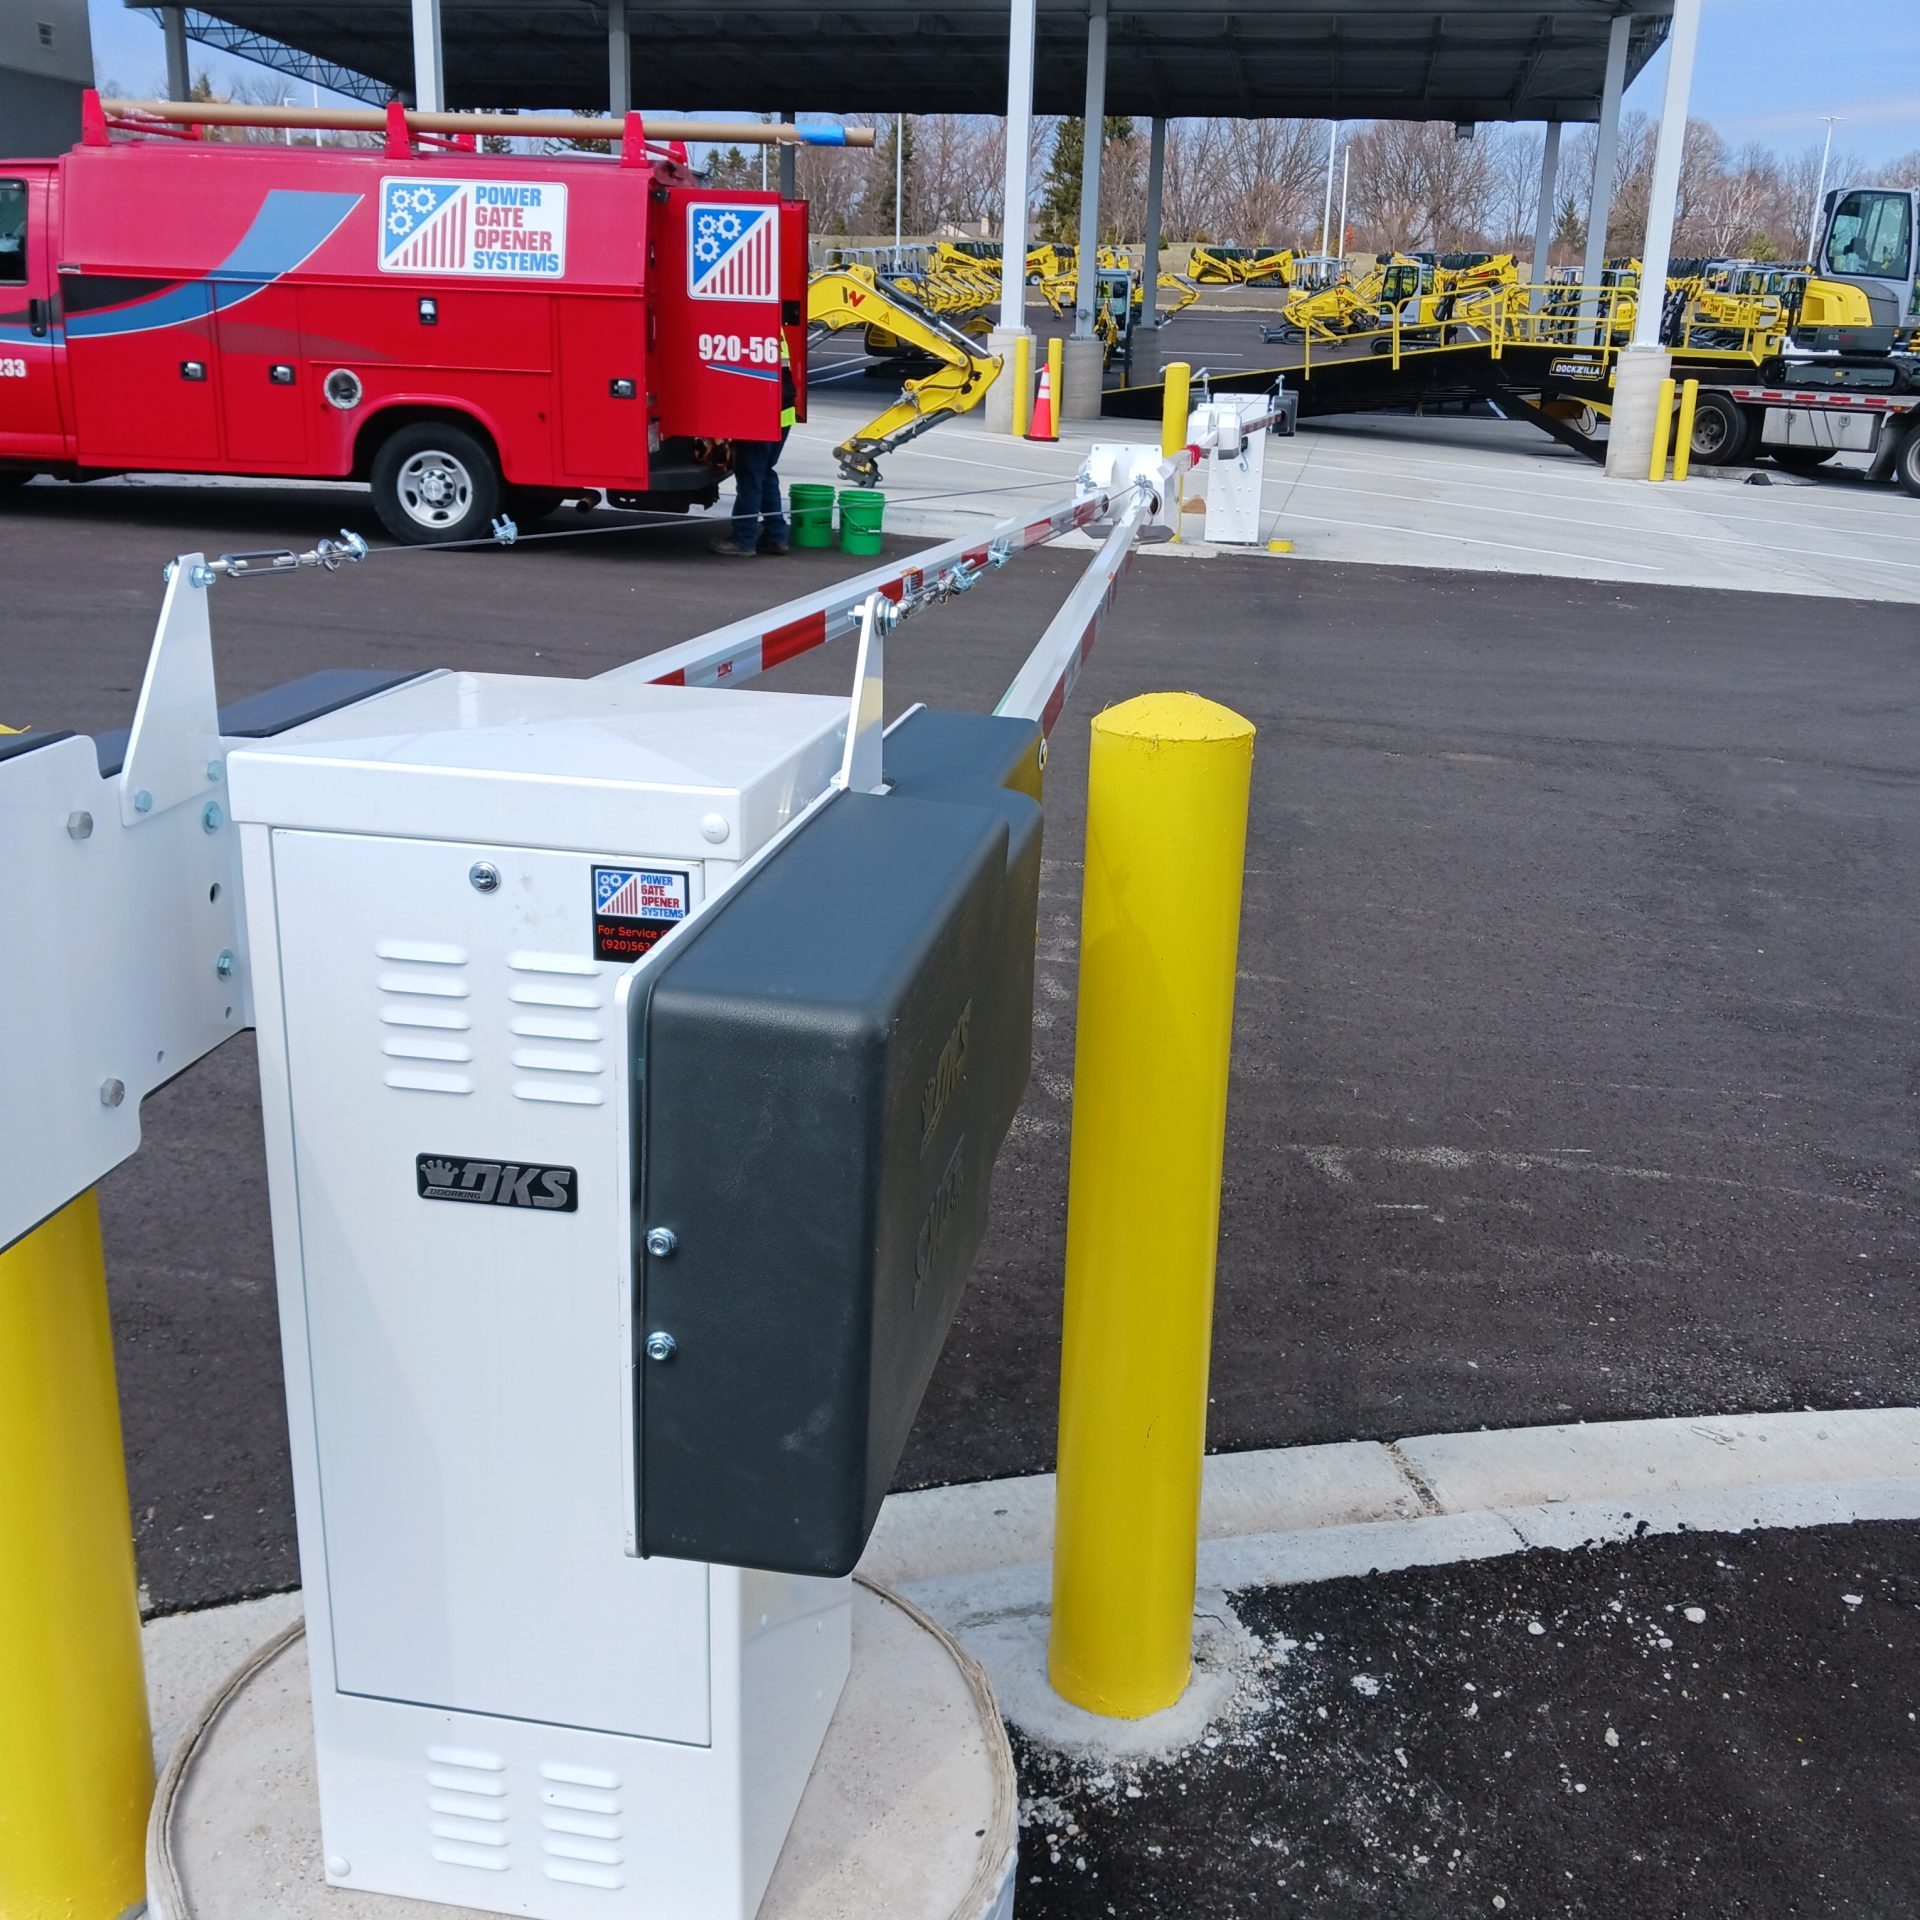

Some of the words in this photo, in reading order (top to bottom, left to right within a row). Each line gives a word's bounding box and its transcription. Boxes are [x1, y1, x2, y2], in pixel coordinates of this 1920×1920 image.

[475, 186, 542, 206] POWER
[474, 207, 524, 227] GATE
[474, 229, 552, 251] OPENER
[473, 252, 559, 272] SYSTEMS
[698, 334, 778, 364] 920-56
[1556, 364, 1600, 375] DOCKZILLA
[640, 874, 673, 886] POWER
[641, 885, 665, 896] GATE
[641, 896, 679, 908] OPENER
[641, 907, 684, 919] SYSTEMS
[597, 925, 615, 935] For
[618, 927, 657, 939] Service
[430, 1188, 481, 1200] DOORKING
